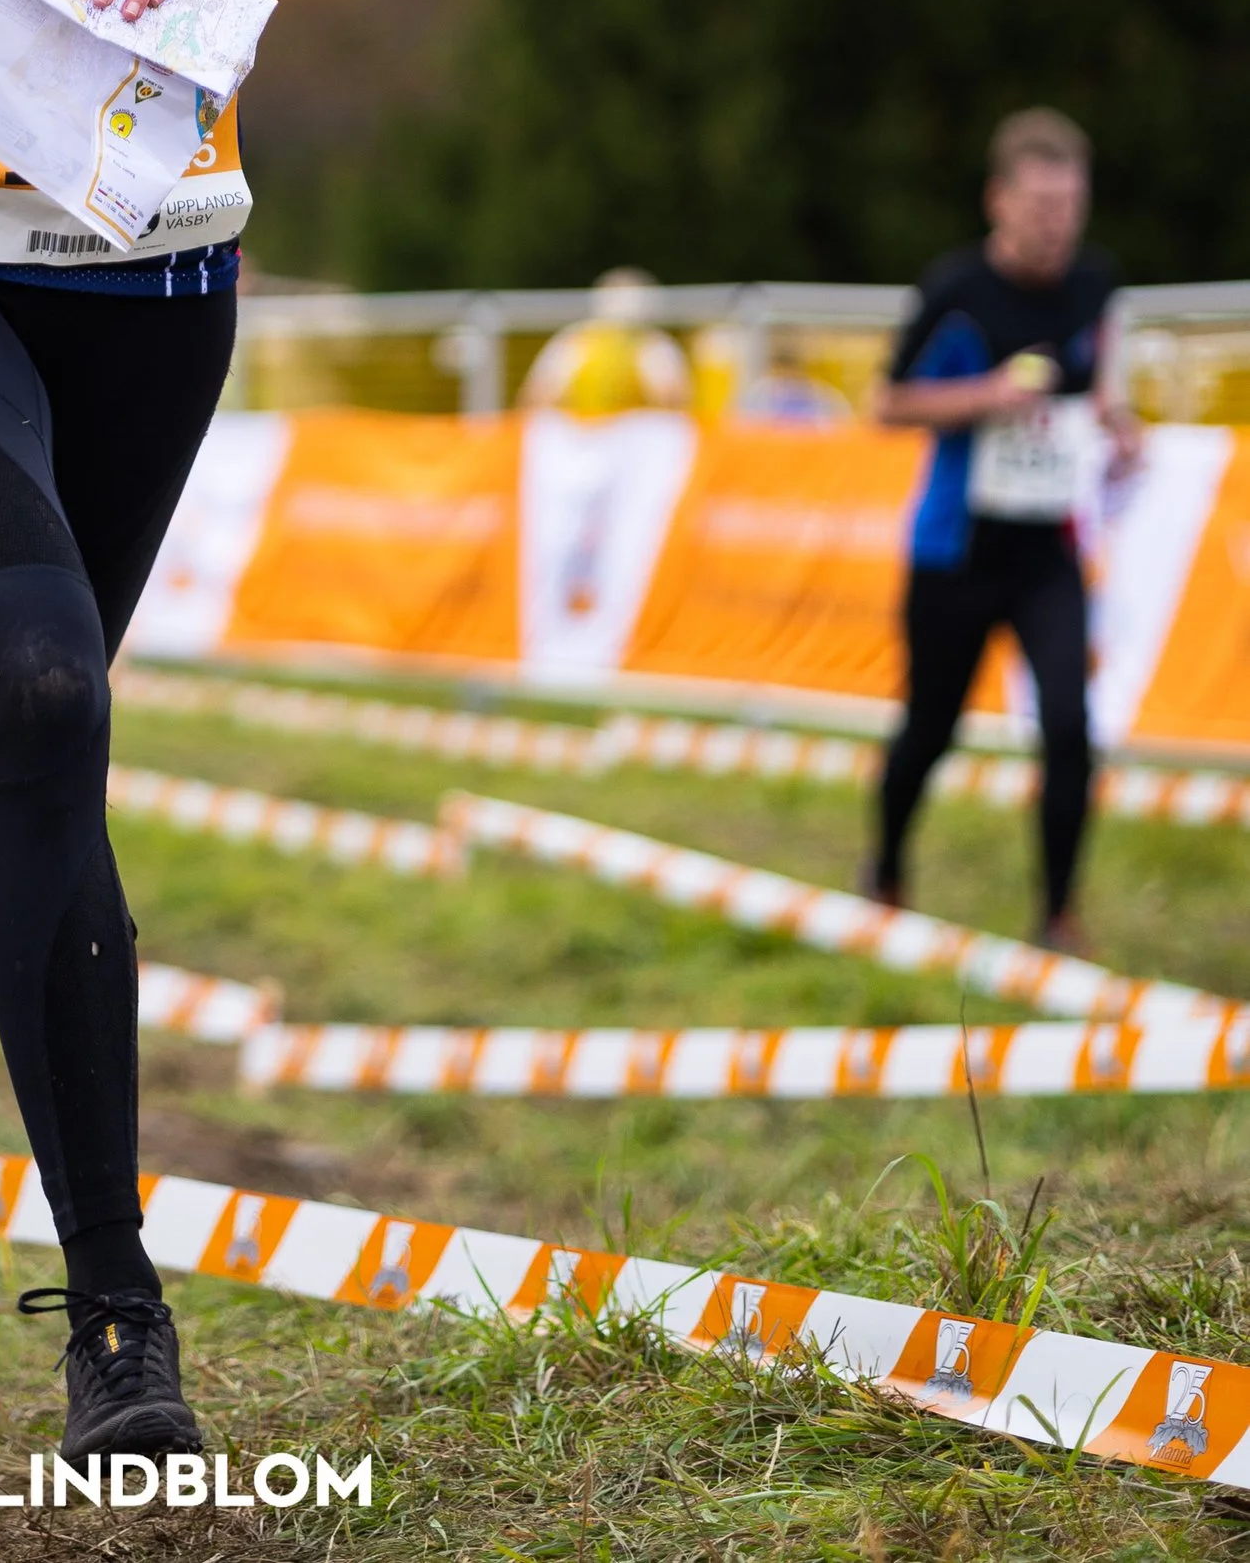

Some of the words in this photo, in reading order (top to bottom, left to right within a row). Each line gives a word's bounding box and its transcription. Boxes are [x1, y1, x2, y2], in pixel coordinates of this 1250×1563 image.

[166, 191, 244, 216] UPPLANDS
[166, 212, 213, 230] VÄSBY
[938, 1322, 970, 1378] 25
[1170, 1366, 1206, 1425] 25
